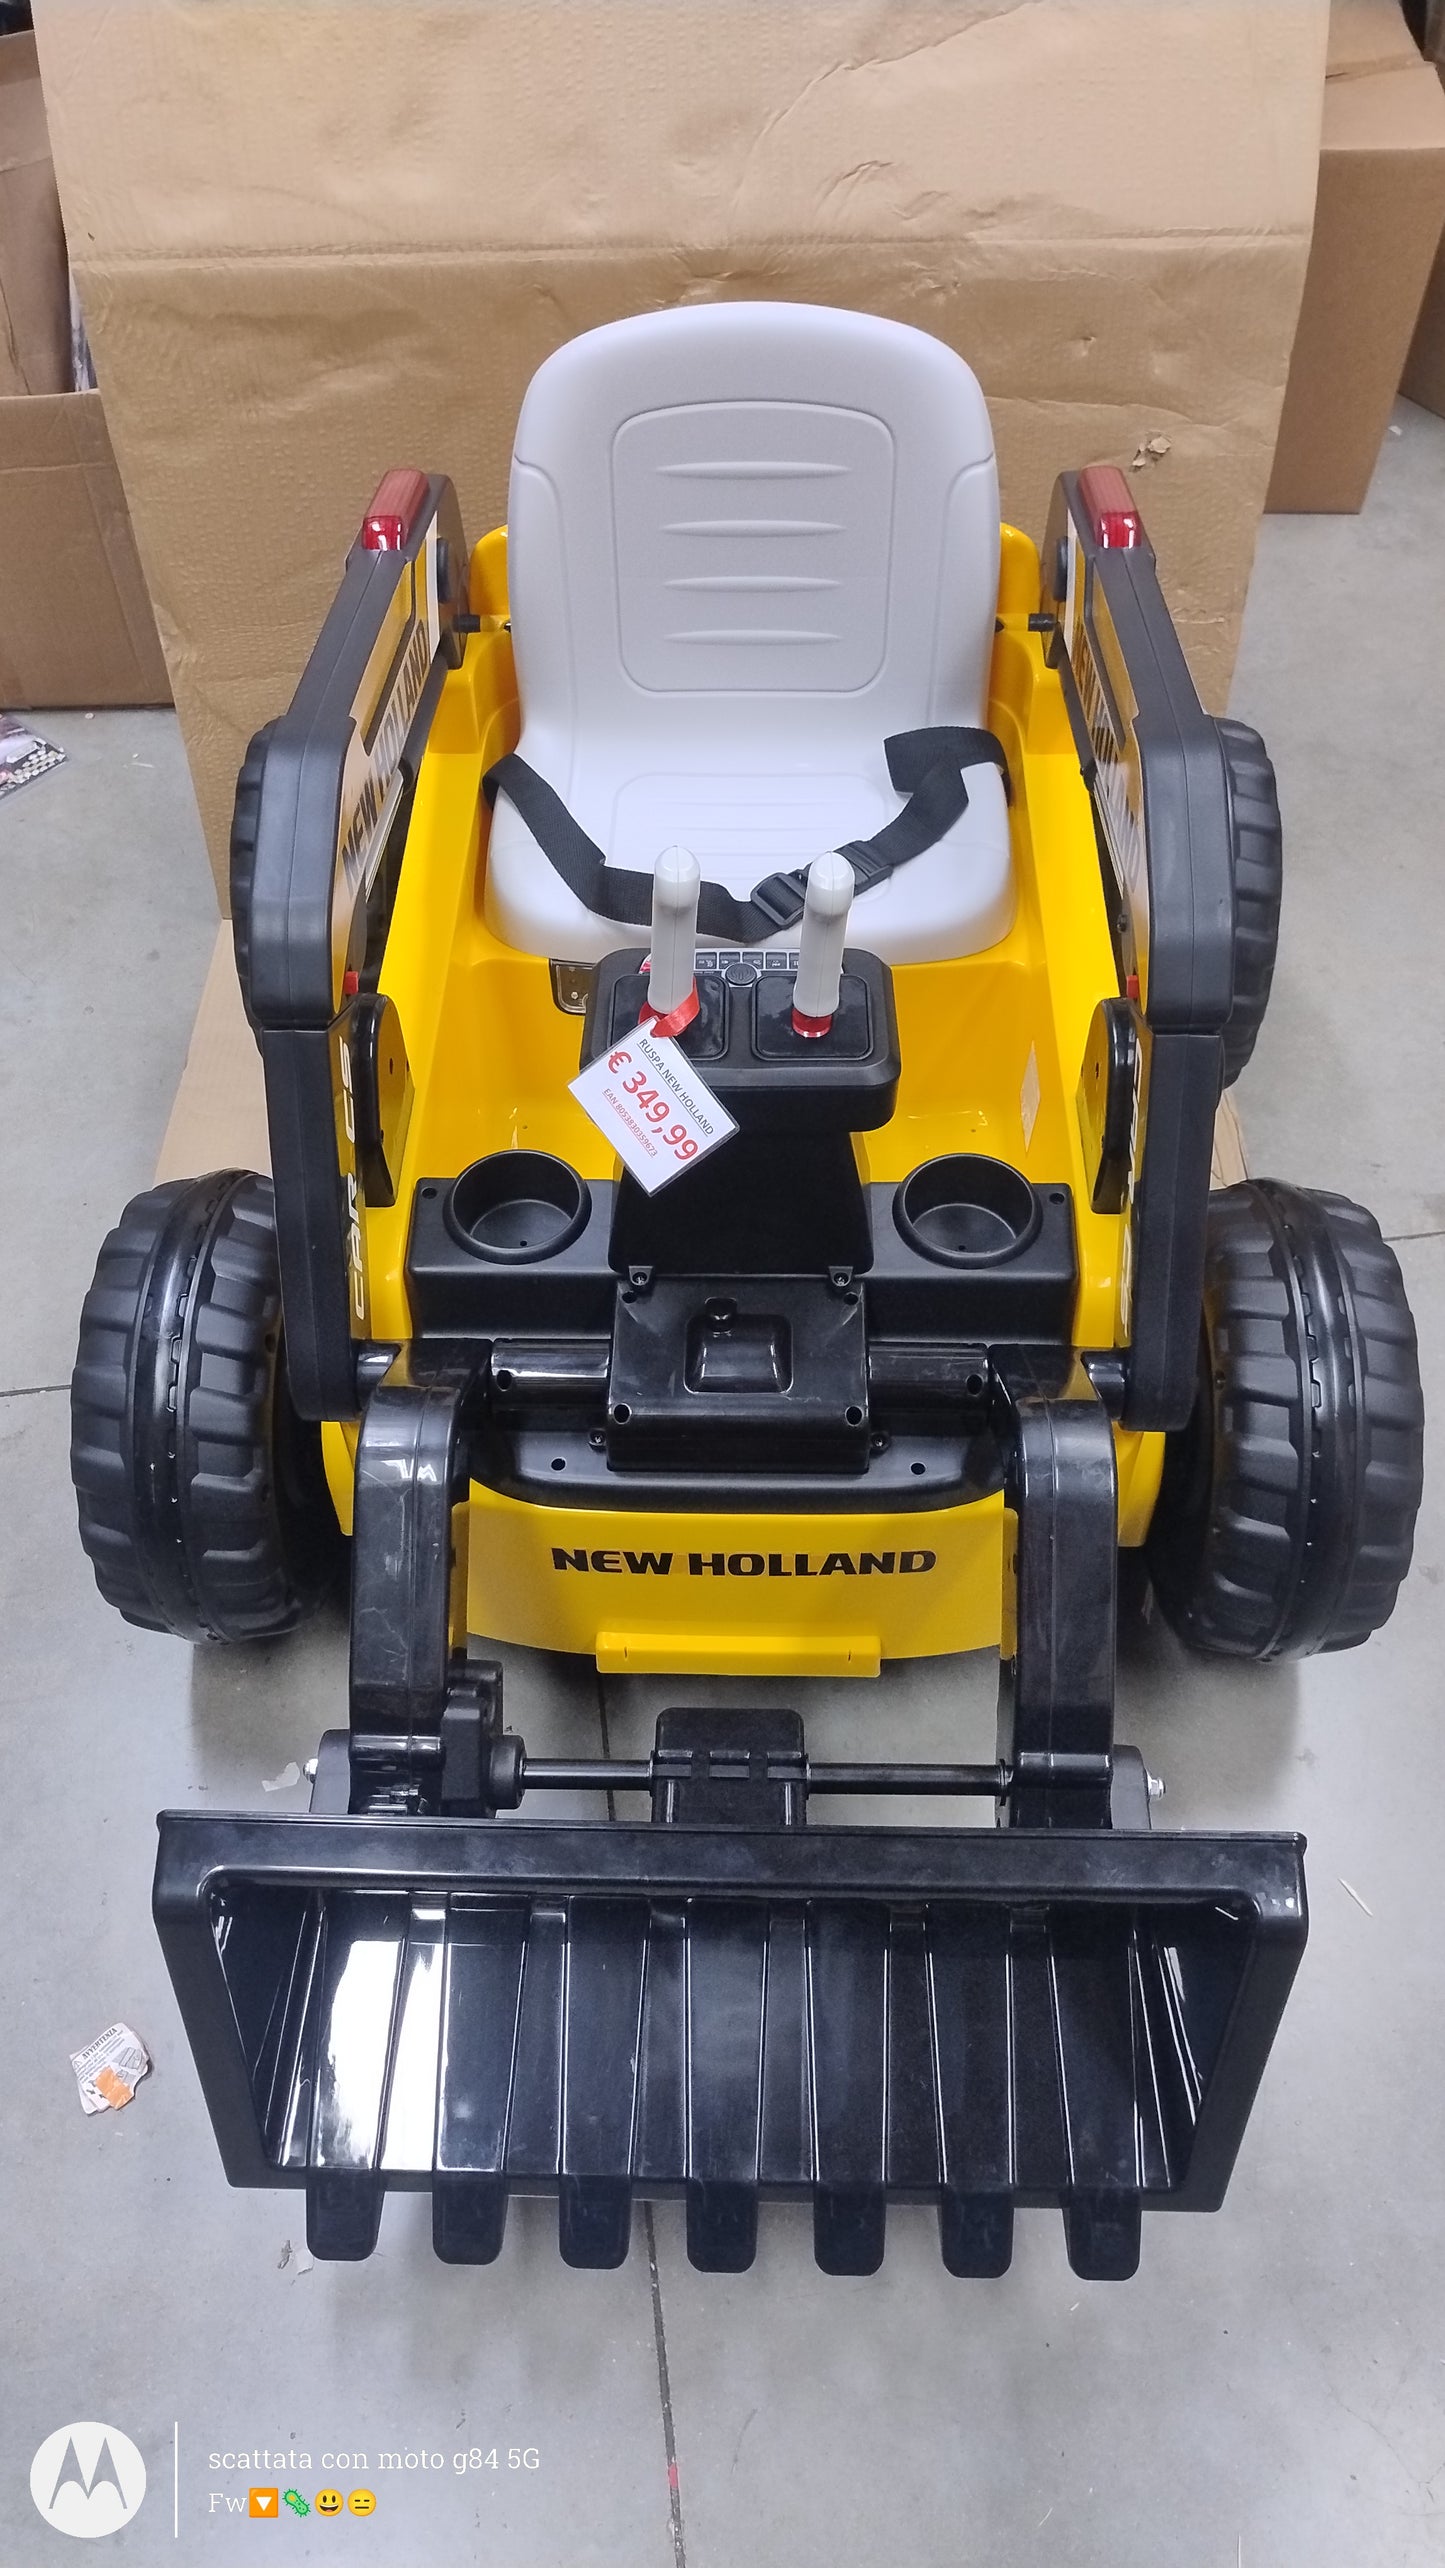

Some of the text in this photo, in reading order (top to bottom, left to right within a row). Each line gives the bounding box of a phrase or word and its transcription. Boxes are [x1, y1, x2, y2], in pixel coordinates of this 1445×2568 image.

[342, 618, 429, 898] NEW HOLLAND
[603, 1087, 619, 1106] EAN
[607, 1050, 699, 1160] € 349,99
[638, 1037, 715, 1136] RUSPA NEW HOLLAND
[347, 1173, 365, 1320] CAR
[551, 1547, 938, 1576] NEW HOLLAND
